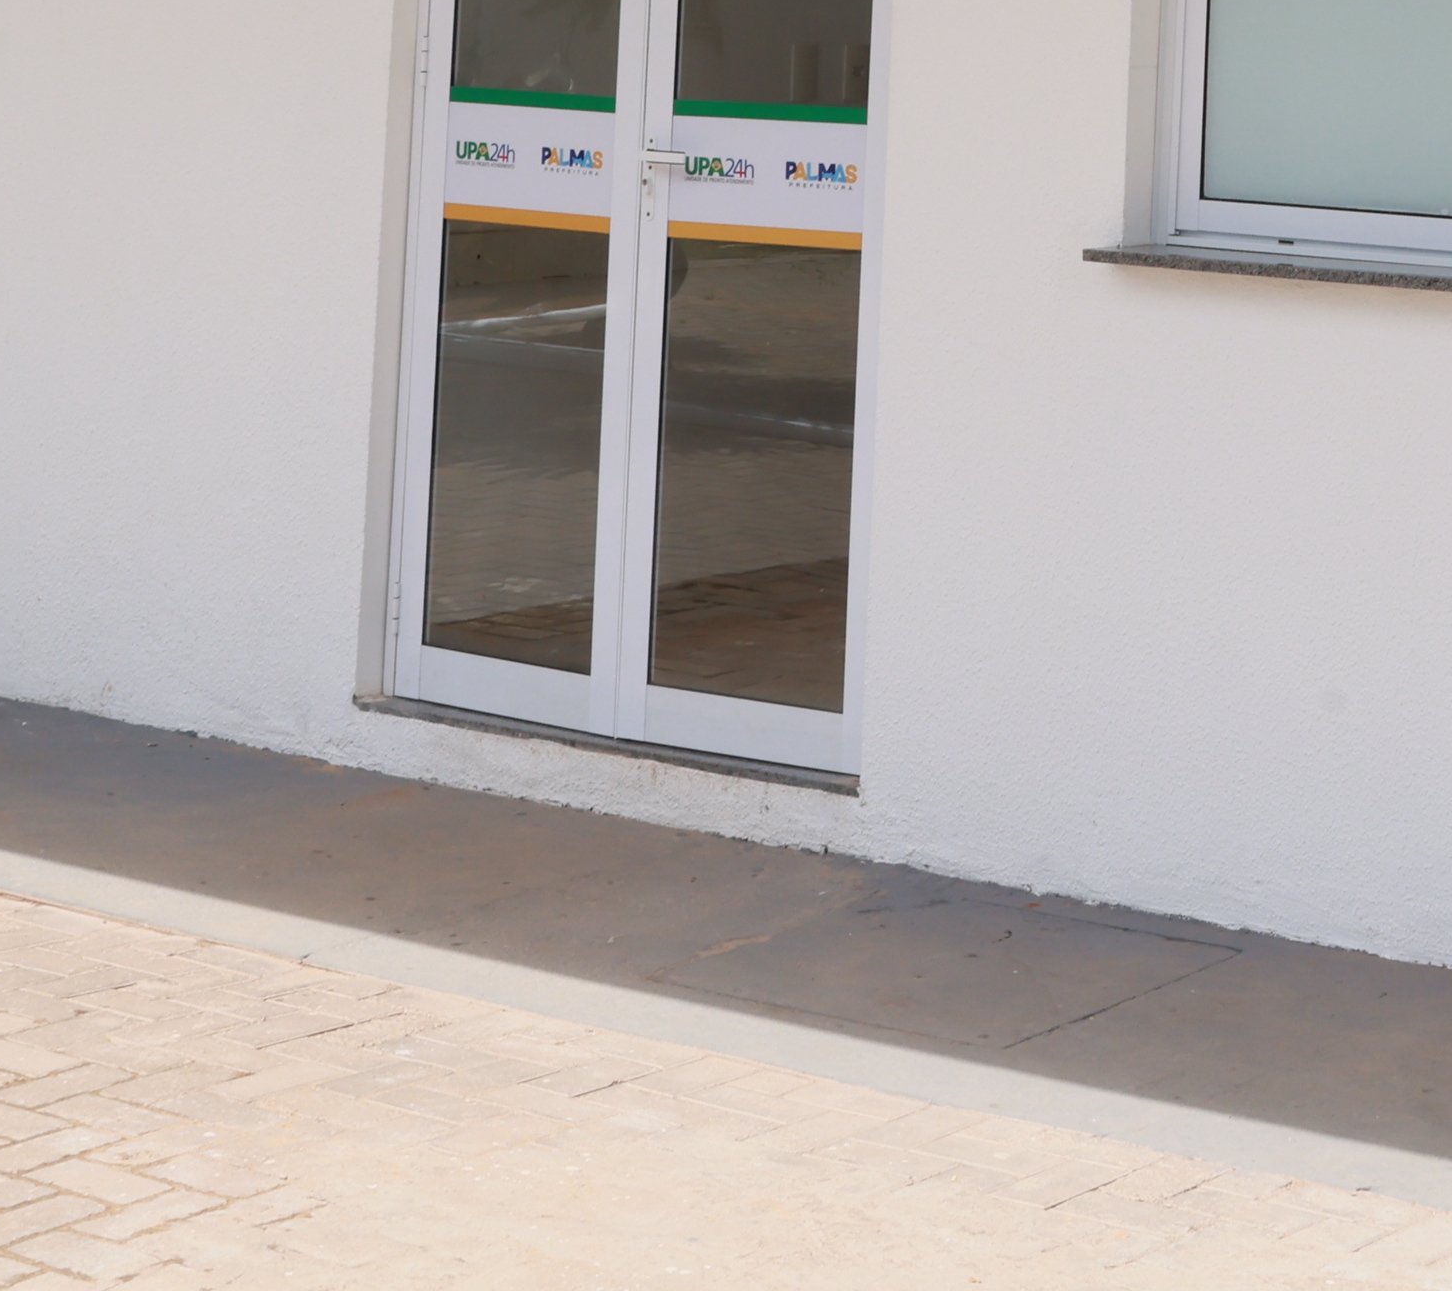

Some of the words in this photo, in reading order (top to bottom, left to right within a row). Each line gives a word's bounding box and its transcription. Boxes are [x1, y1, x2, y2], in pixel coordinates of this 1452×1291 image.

[542, 147, 603, 169] PALMAS
[544, 167, 599, 176] PREFEITURA
[786, 161, 857, 184] PALMAS
[789, 182, 853, 191] PREFEITURA
